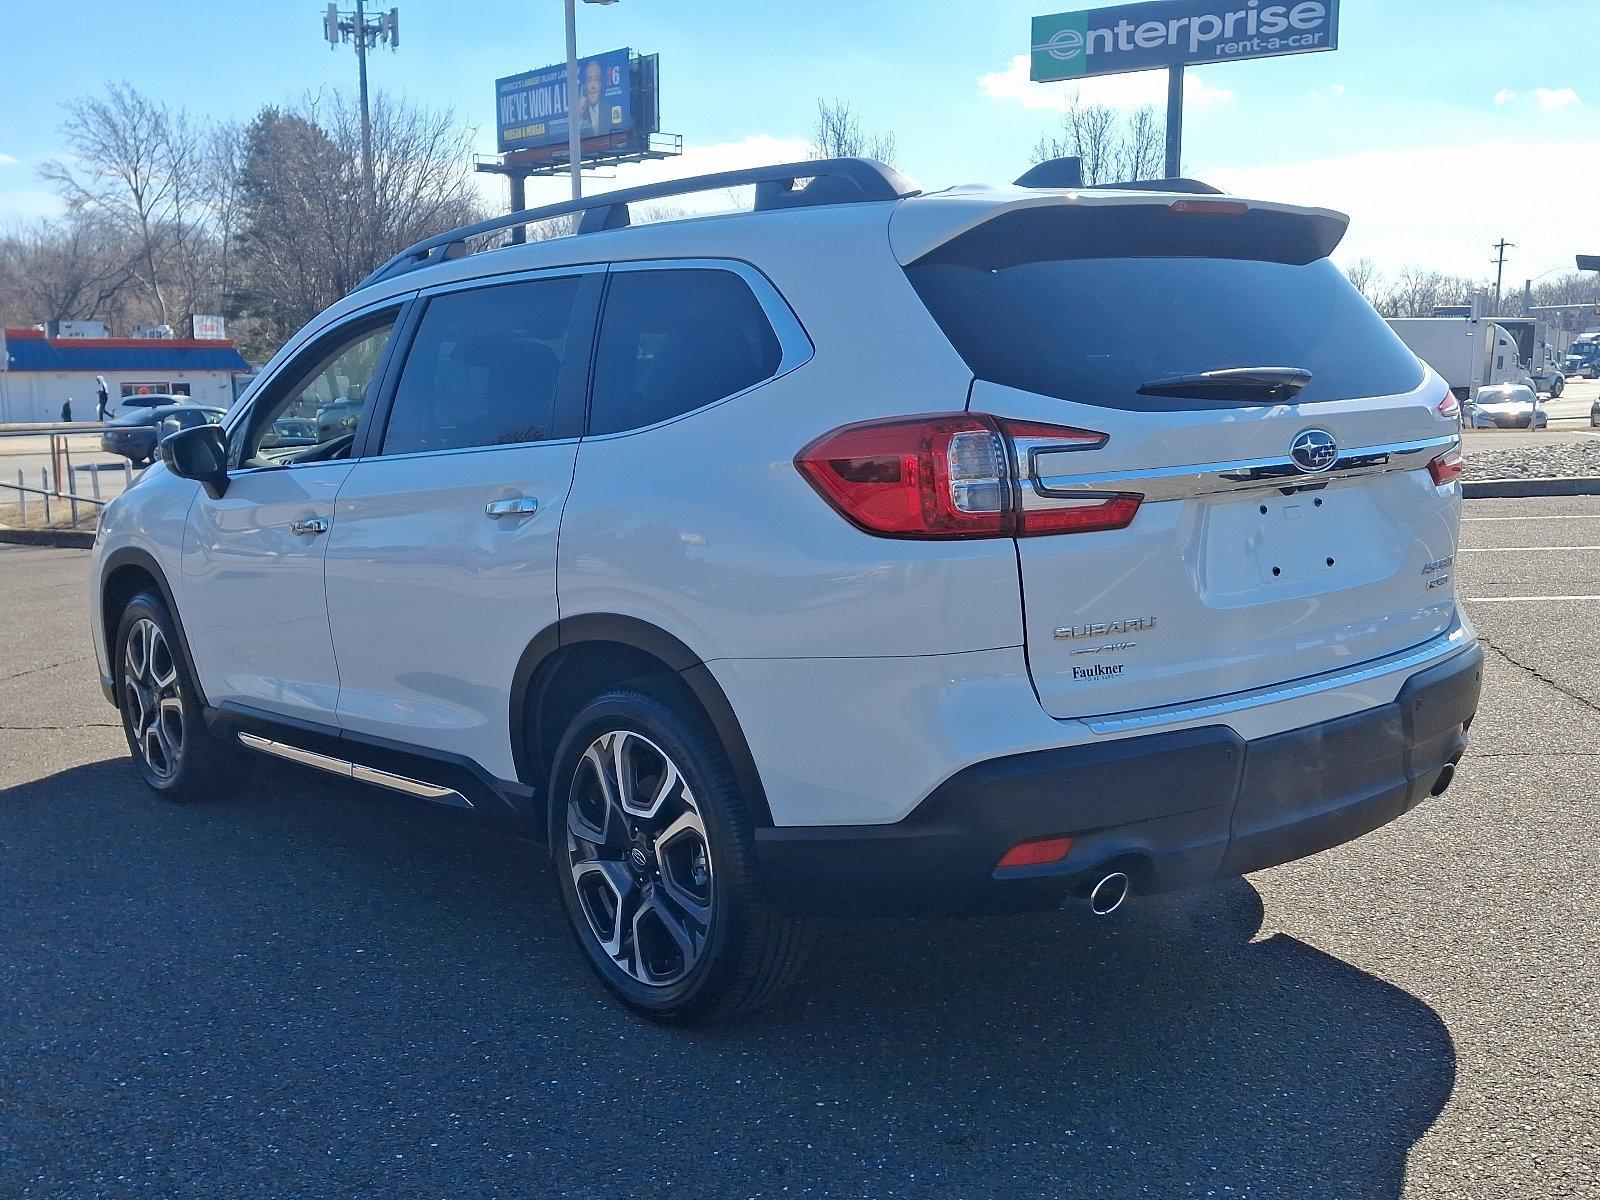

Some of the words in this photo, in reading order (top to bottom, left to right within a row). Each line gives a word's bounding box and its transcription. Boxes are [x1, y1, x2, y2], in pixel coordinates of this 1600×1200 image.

[1047, 0, 1326, 60] enterprise
[1215, 31, 1324, 55] rent-a-car
[500, 91, 528, 124] WE'VE
[529, 86, 552, 119] WON
[554, 84, 562, 114] A
[1054, 616, 1157, 640] SUBARU
[1072, 664, 1124, 679] Faulkner
